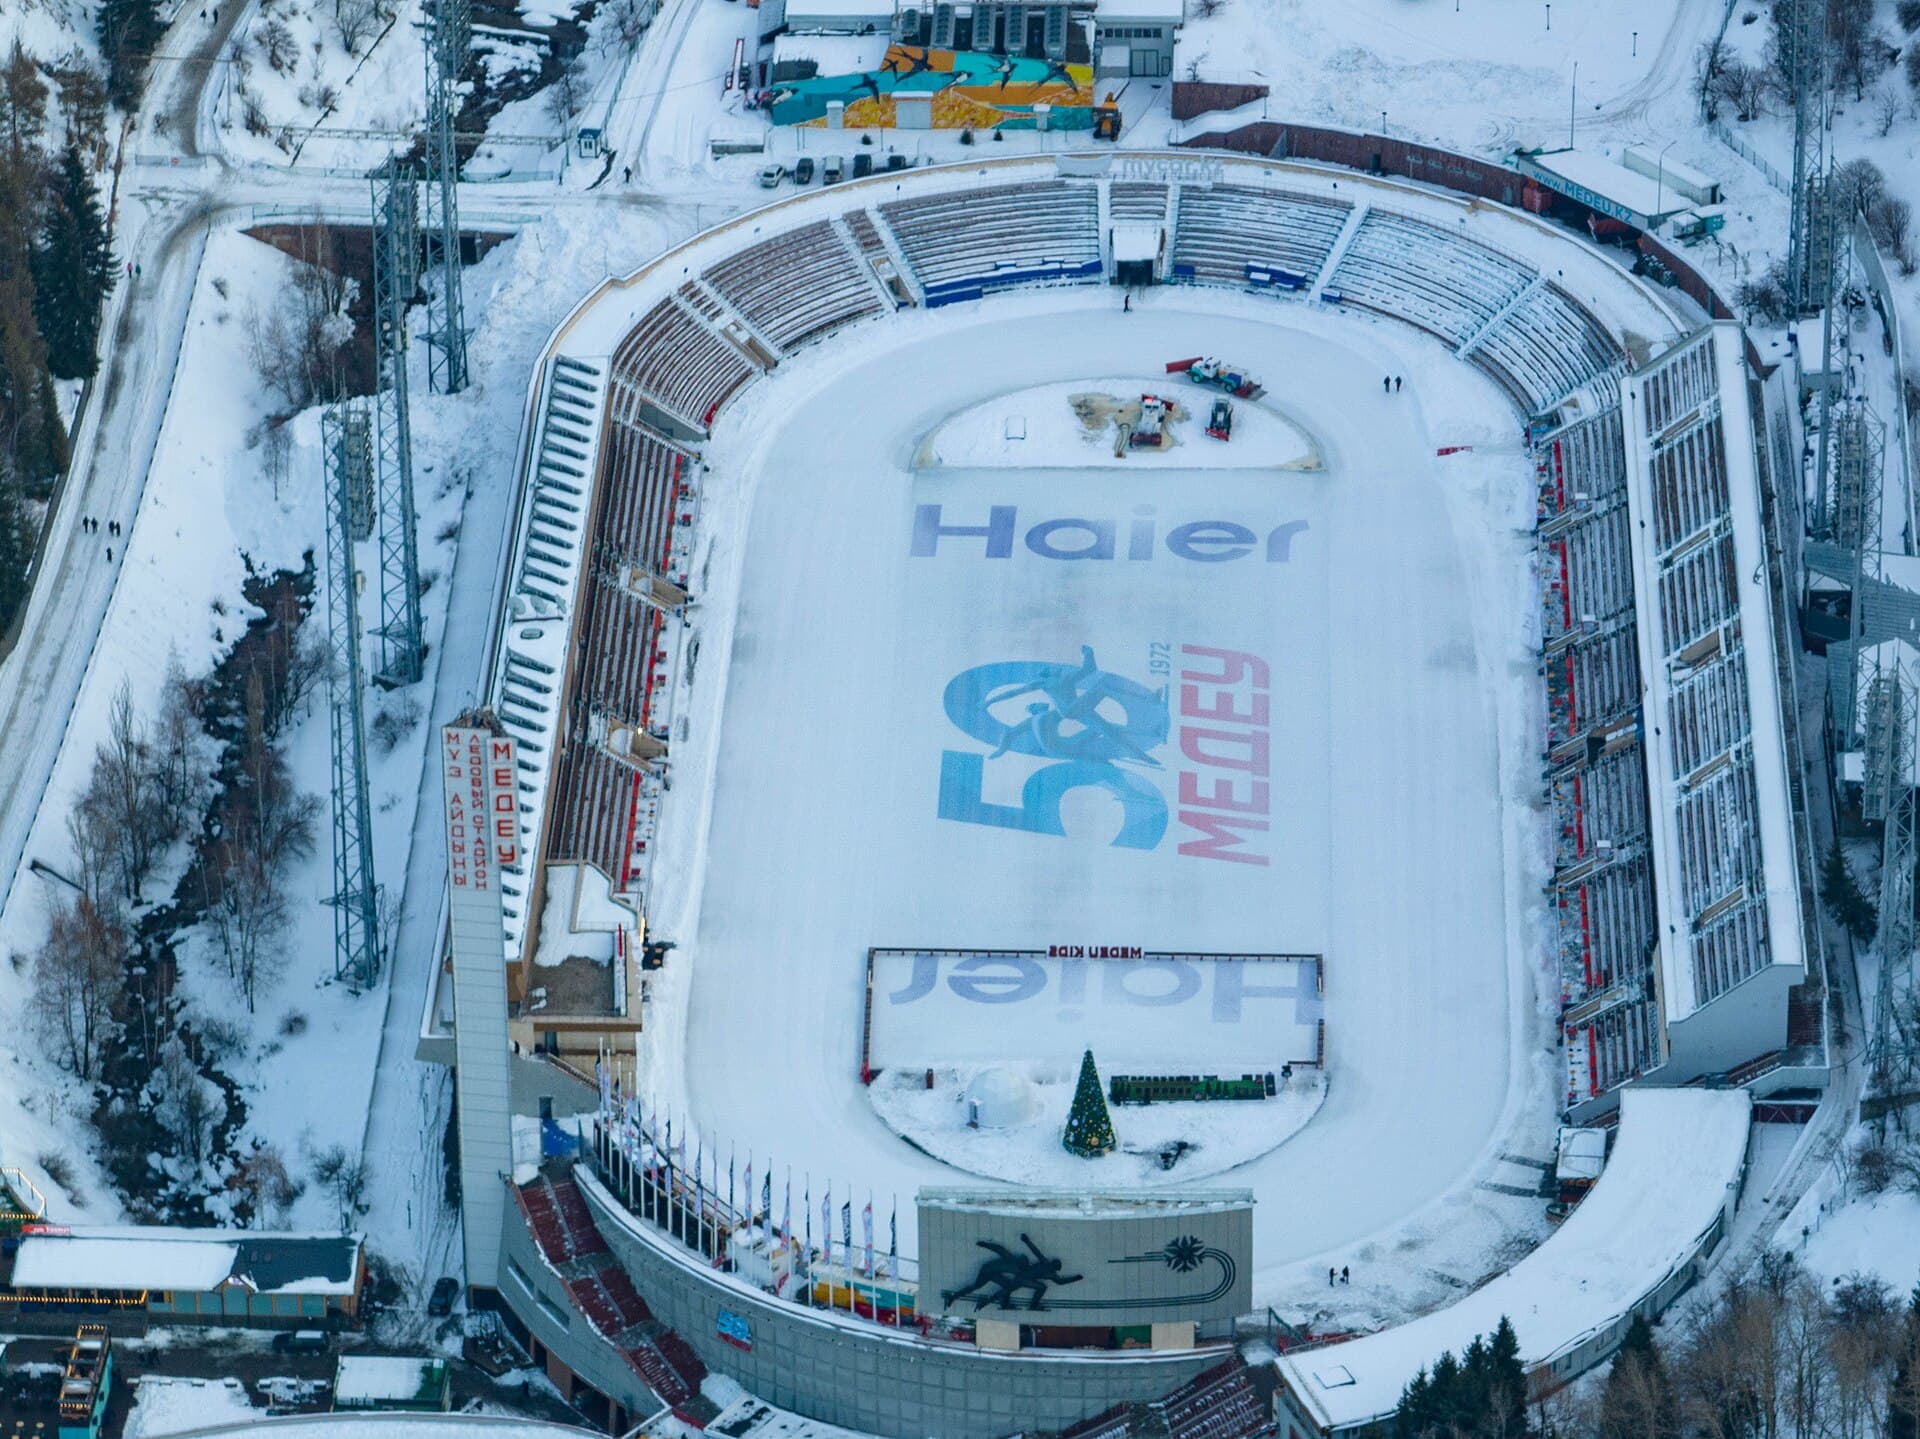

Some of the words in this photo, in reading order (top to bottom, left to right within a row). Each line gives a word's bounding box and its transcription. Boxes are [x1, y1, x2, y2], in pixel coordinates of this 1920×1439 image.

[1532, 170, 1633, 225] www.MEDEU.KZ
[910, 503, 1310, 563] Haier
[1150, 641, 1171, 676] 1972
[469, 734, 484, 809] ЛЕДОВЫЙ
[937, 660, 1172, 852] 50
[1177, 643, 1270, 867] МЕДЕУ
[493, 743, 516, 862] МЕДЕУ
[473, 815, 487, 890] СТАДИОН
[888, 956, 1325, 1026] Haier
